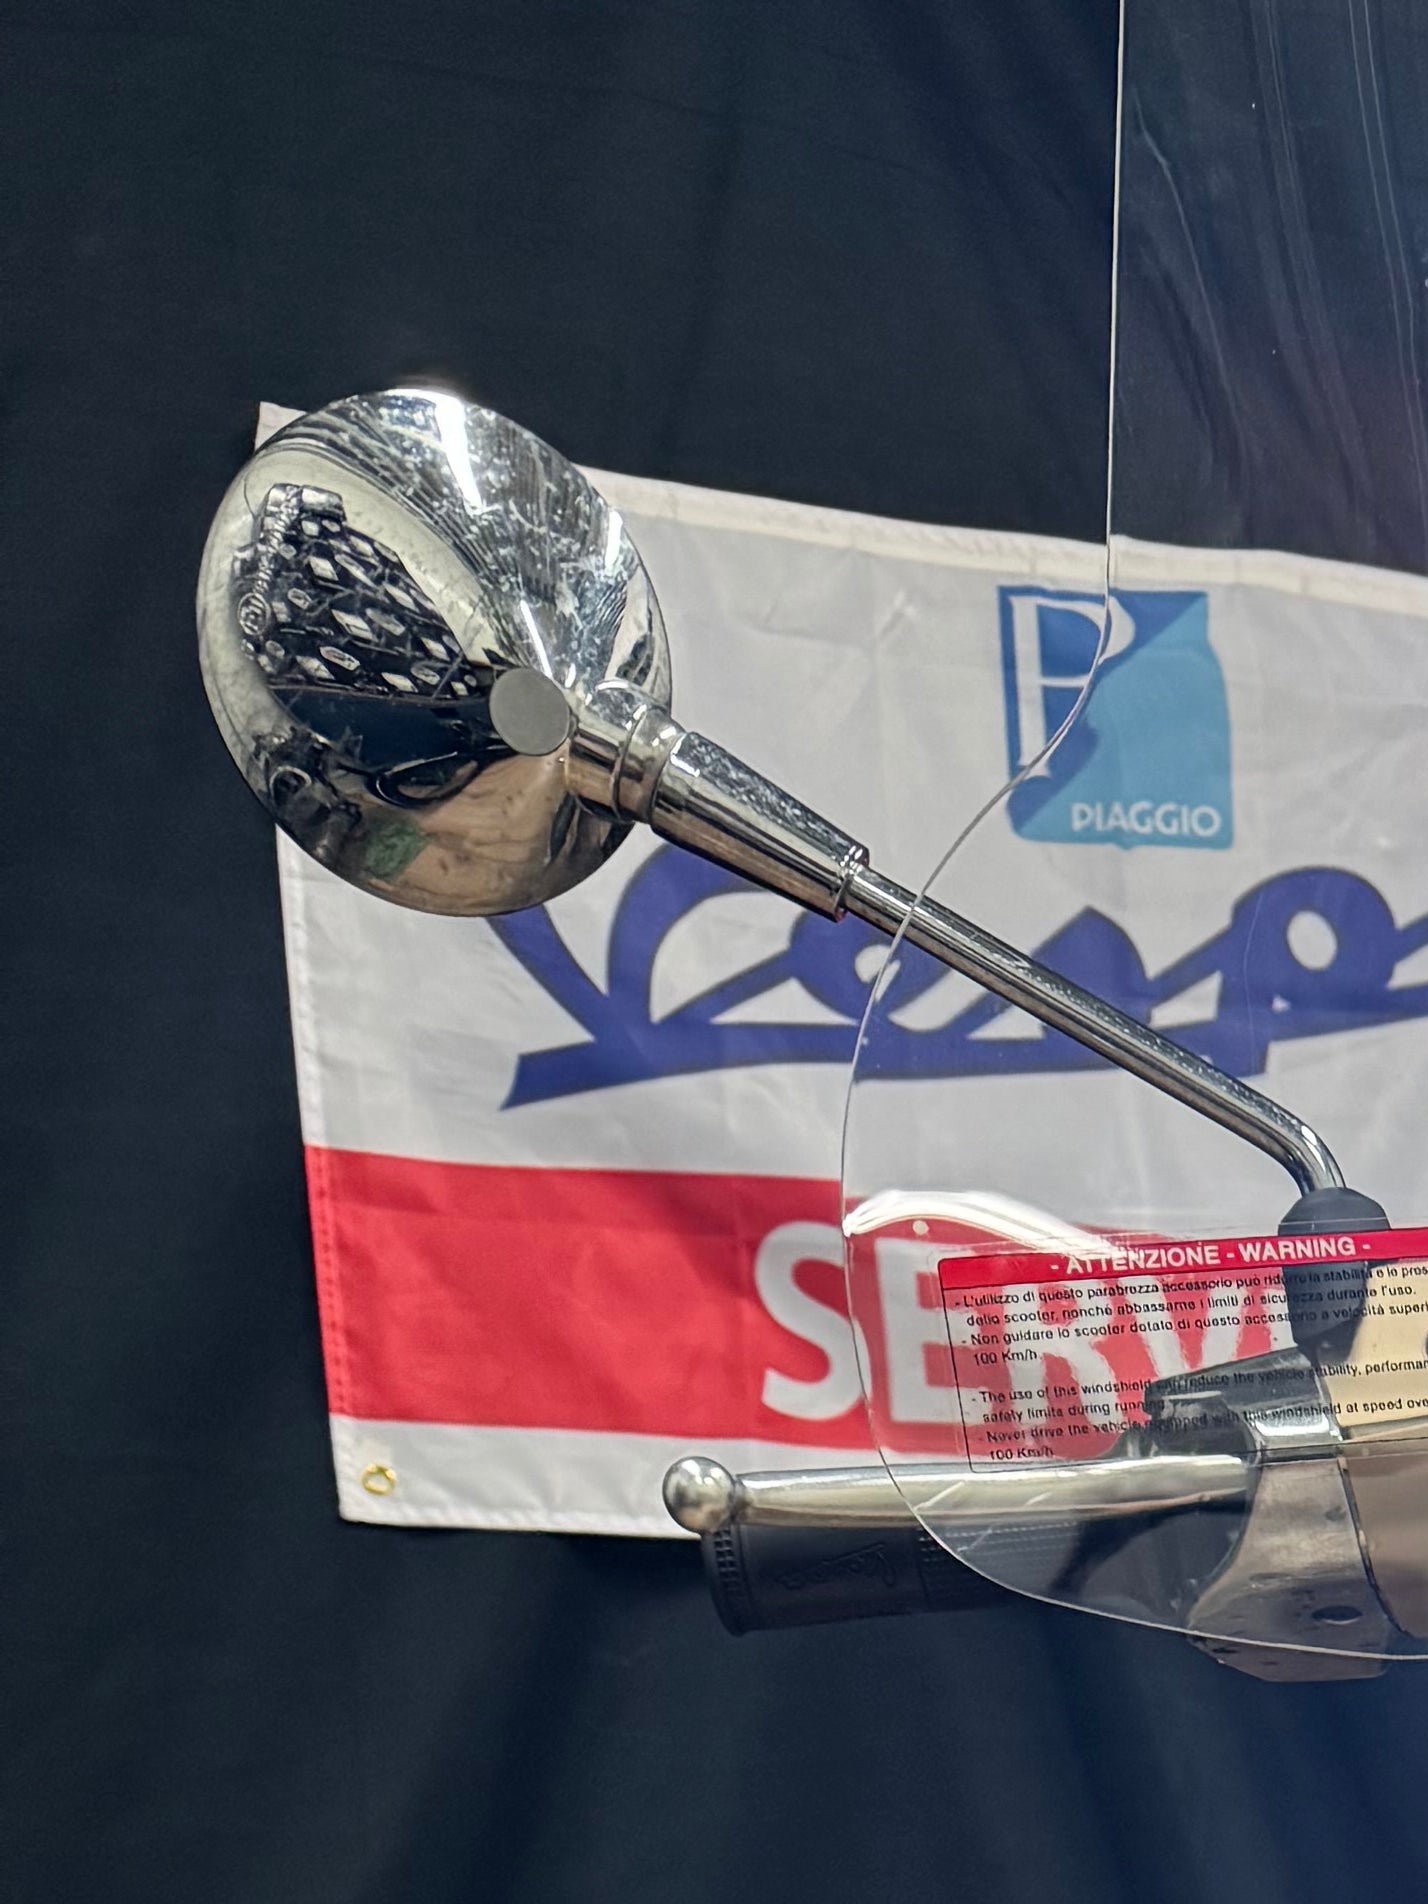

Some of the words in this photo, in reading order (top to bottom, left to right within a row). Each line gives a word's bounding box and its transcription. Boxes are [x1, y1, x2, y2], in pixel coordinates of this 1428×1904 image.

[1071, 800, 1223, 838] PIAGGIO
[1066, 1244, 1222, 1274] ATTENZIONE
[1238, 1236, 1356, 1263] WARNING
[1023, 1291, 1035, 1302] di
[1039, 1288, 1083, 1303] questo
[1087, 1284, 1159, 1299] parabrezza
[1162, 1277, 1232, 1293] accessorio
[1236, 1273, 1260, 1289] può
[1244, 1294, 1255, 1306] di
[970, 1333, 999, 1346] Non
[1003, 1329, 1053, 1345] guidare
[1074, 1322, 1125, 1337] scooter
[1178, 1318, 1190, 1330] di
[1194, 1314, 1240, 1330] questo
[974, 1352, 997, 1366] 100
[979, 1390, 1005, 1403] The
[1009, 1390, 1033, 1401] use
[1037, 1387, 1049, 1399] of
[1054, 1386, 1077, 1398] this
[1080, 1379, 1151, 1396] windshield
[1067, 1402, 1110, 1416] during
[1067, 1424, 1088, 1436] the
[1362, 1397, 1403, 1414] speed
[989, 1449, 1013, 1460] 100
